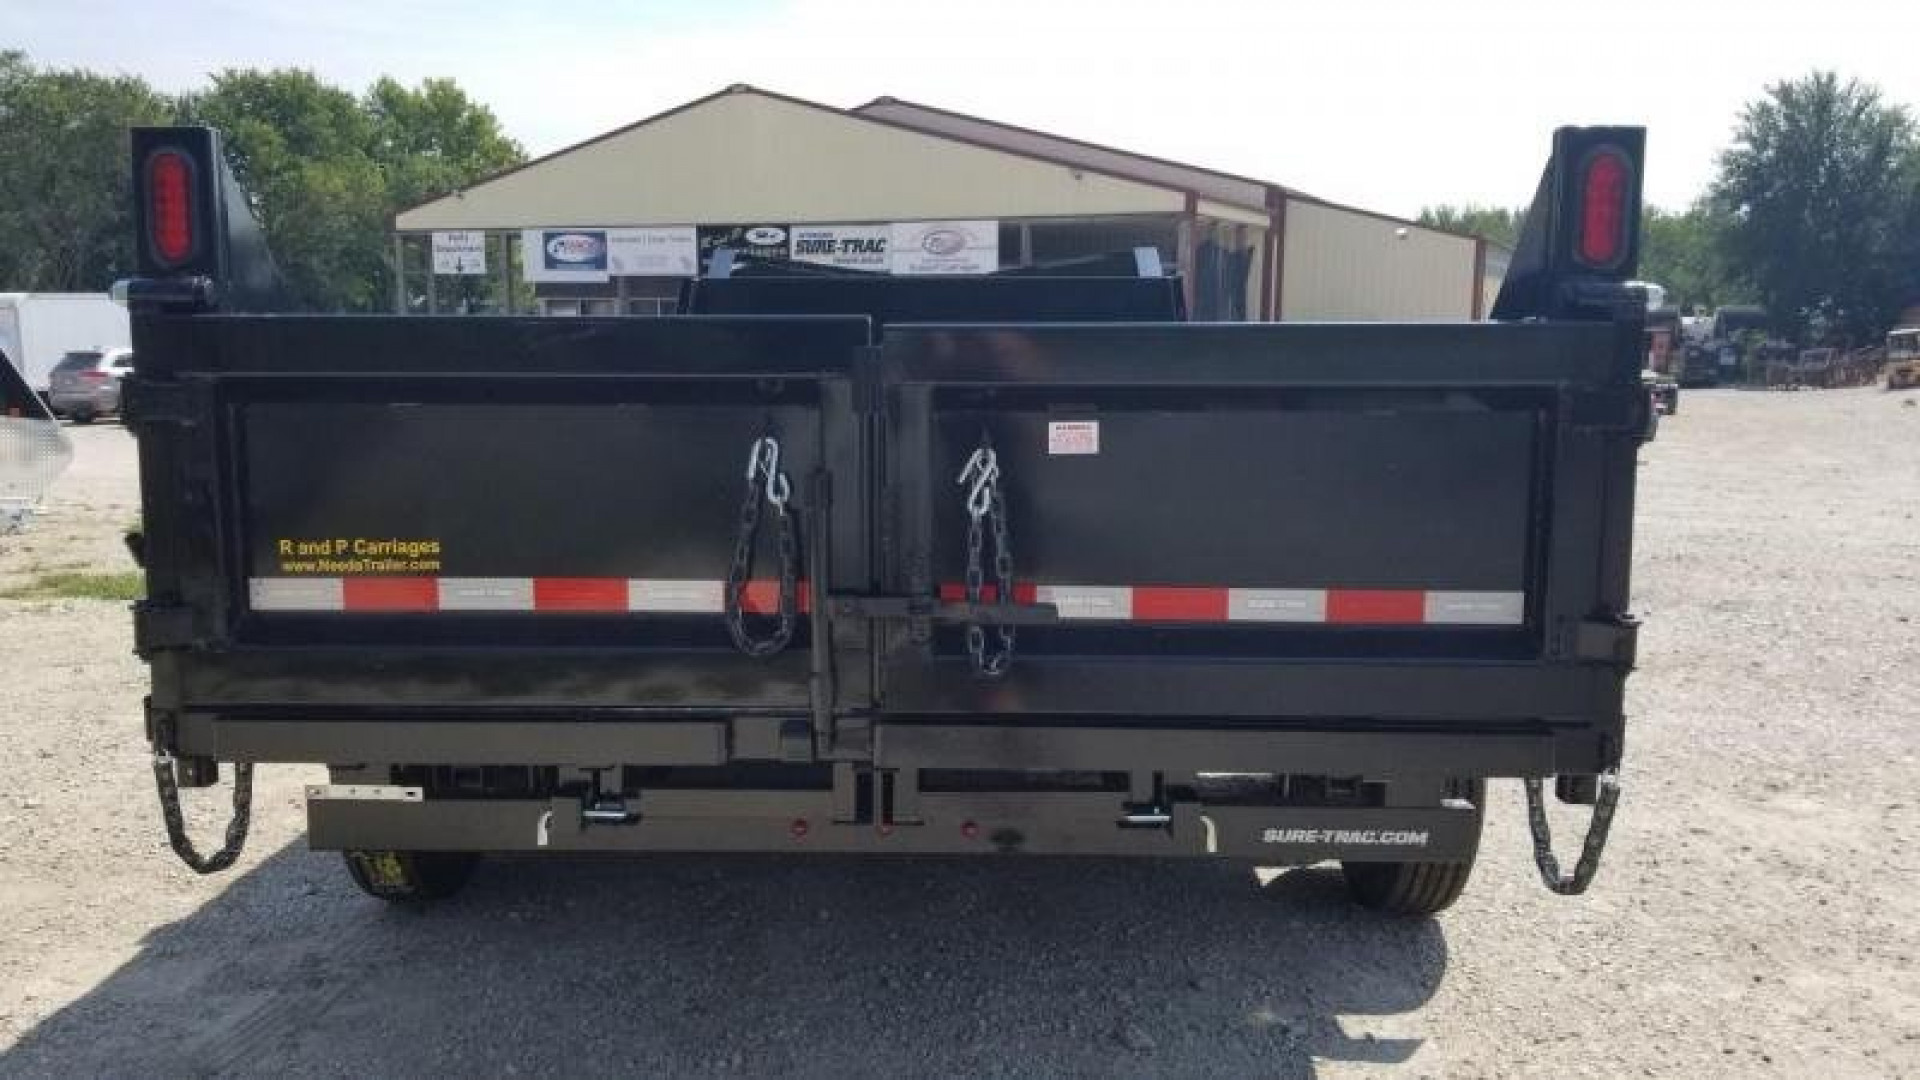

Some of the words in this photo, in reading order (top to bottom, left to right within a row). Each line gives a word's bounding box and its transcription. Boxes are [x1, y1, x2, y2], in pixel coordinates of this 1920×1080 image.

[795, 239, 887, 254] SURE-TRAC
[280, 539, 292, 554] R
[299, 539, 330, 555] and
[336, 539, 349, 554] P
[354, 538, 440, 557] Carriages
[1263, 829, 1429, 846] SURE-TRAC.COM
